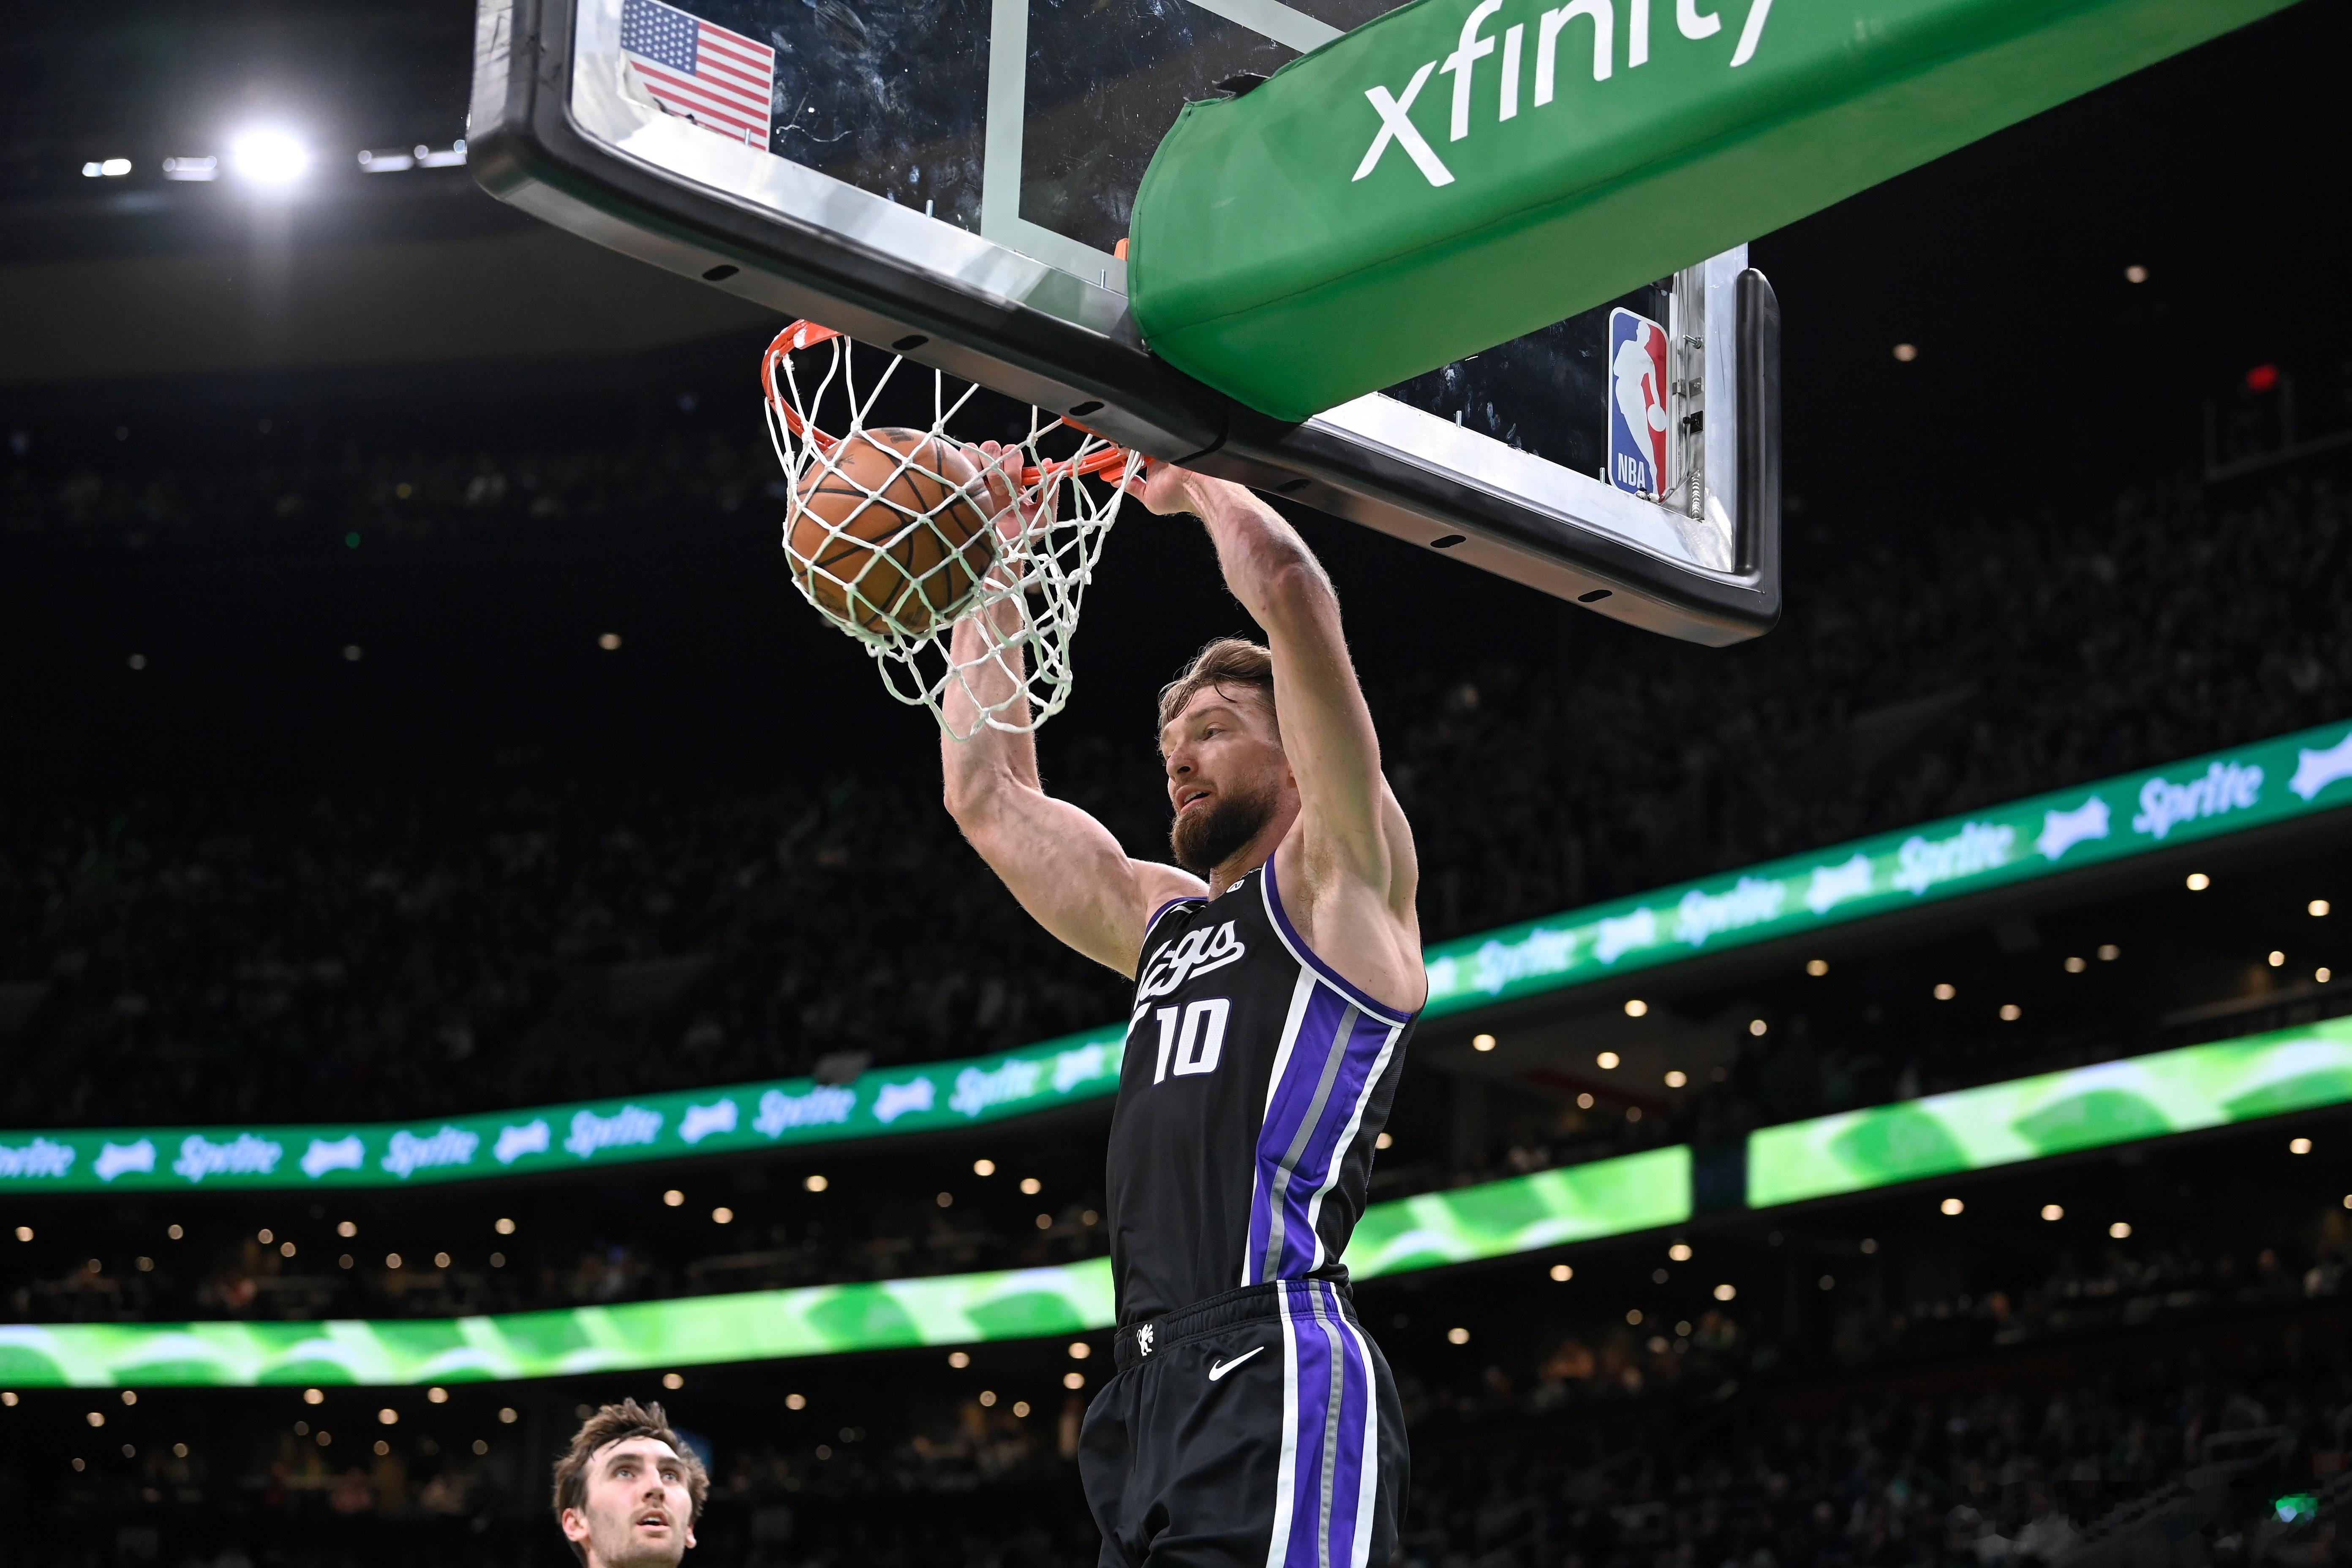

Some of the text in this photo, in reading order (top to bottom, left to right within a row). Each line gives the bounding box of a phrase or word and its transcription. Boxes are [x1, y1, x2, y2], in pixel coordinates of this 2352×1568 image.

[1618, 452, 1646, 489] NBA
[1892, 821, 2015, 896] Sprite
[2132, 761, 2265, 839] Sprite
[1154, 998, 1230, 1085] 10
[173, 1133, 282, 1183] Sprite
[381, 1124, 479, 1179] Sprite
[564, 1104, 663, 1160] Sprite
